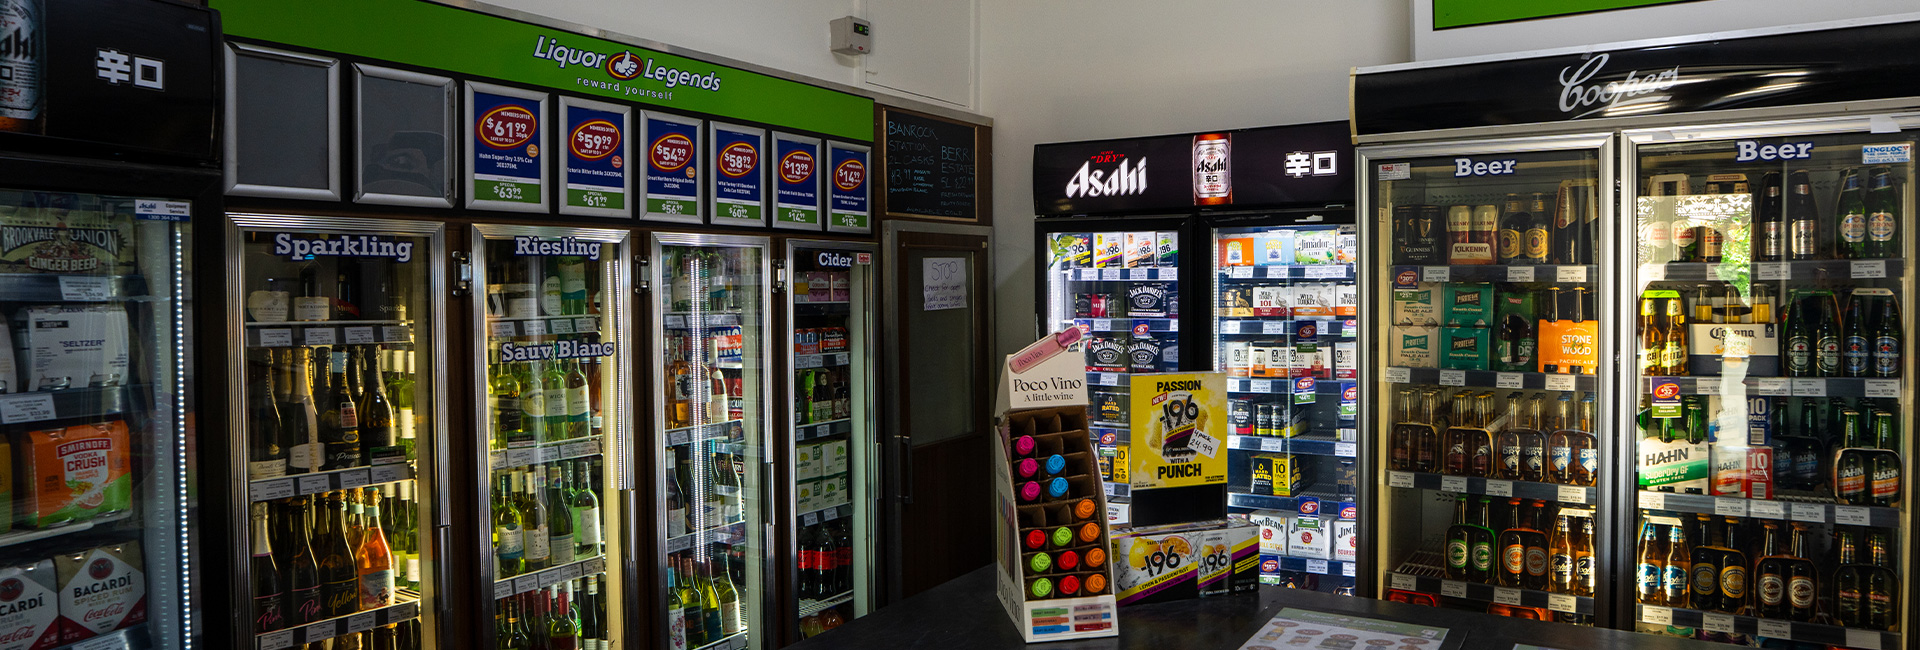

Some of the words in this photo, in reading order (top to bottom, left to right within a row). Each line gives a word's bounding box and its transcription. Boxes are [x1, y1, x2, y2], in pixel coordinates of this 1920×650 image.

[96, 48, 165, 91] 辛口
[534, 35, 606, 69] Liquor
[643, 58, 721, 92] Legends
[577, 77, 620, 92] reward
[625, 84, 673, 101] yourself
[1558, 53, 1680, 114] Coopers
[888, 121, 938, 140] BANROCK
[888, 140, 931, 153] STATION
[941, 146, 974, 161] BERRI
[1737, 140, 1812, 162] Beer
[903, 155, 935, 165] CASKS
[1197, 157, 1227, 172] Asahi
[1284, 151, 1337, 178] 辛口
[1455, 158, 1516, 177] Beer
[941, 163, 975, 175] ESTATE
[1065, 156, 1148, 198] Asahi
[2, 228, 55, 251] BROOKVALE
[70, 230, 118, 256] UNION
[275, 233, 413, 262] Sparkling
[515, 236, 601, 259] Riesling
[1455, 246, 1488, 254] KILKENNY
[29, 256, 69, 271] GINGER
[70, 257, 98, 271] BEER
[819, 252, 852, 267] Cider
[932, 261, 958, 281] STOP
[1129, 286, 1142, 299] JACK
[1142, 285, 1163, 299] DANIEL'S
[1561, 335, 1592, 344] STONE
[1710, 327, 1754, 340] Coona
[1092, 343, 1104, 353] JACK
[1105, 341, 1125, 354] DANIEL'S
[1127, 343, 1139, 354] JACK
[1140, 342, 1159, 355] DANIEL'S
[1405, 339, 1418, 347] PIRATE
[1454, 340, 1468, 348] PIRATE
[1562, 346, 1592, 355] WOOD
[502, 342, 553, 361] Sauv
[558, 341, 614, 357] Blanc
[1014, 379, 1047, 392] Poco
[1050, 377, 1081, 390] Vino
[1157, 380, 1201, 392] PASSION
[1024, 394, 1030, 402] A
[1032, 393, 1052, 401] little
[1053, 392, 1073, 400] wine
[1160, 394, 1199, 431] -196
[1748, 398, 1766, 415] 10
[61, 440, 108, 455] SMIRNOFF
[1189, 439, 1213, 455] 24.99
[67, 456, 106, 472] CRUSH
[1646, 447, 1689, 466] HAHN
[1750, 453, 1768, 469] 10
[1796, 453, 1817, 462] HAHN
[1158, 463, 1201, 479] PUNCH
[1274, 463, 1286, 474] 10
[1645, 466, 1679, 480] SuperDry
[1680, 465, 1689, 474] GF
[1718, 461, 1740, 471] HAHN
[1839, 467, 1864, 478] HAHN
[1873, 469, 1899, 480] HAHN
[1265, 517, 1283, 533] BEAM
[1338, 527, 1351, 538] JIM
[1141, 545, 1180, 578] -196
[74, 572, 132, 598] BACARDÍ
[1139, 582, 1154, 591] LEMON
[1158, 566, 1189, 583] PASSIONFRUIT
[74, 592, 108, 606] SPICED
[113, 586, 133, 596] RUM
